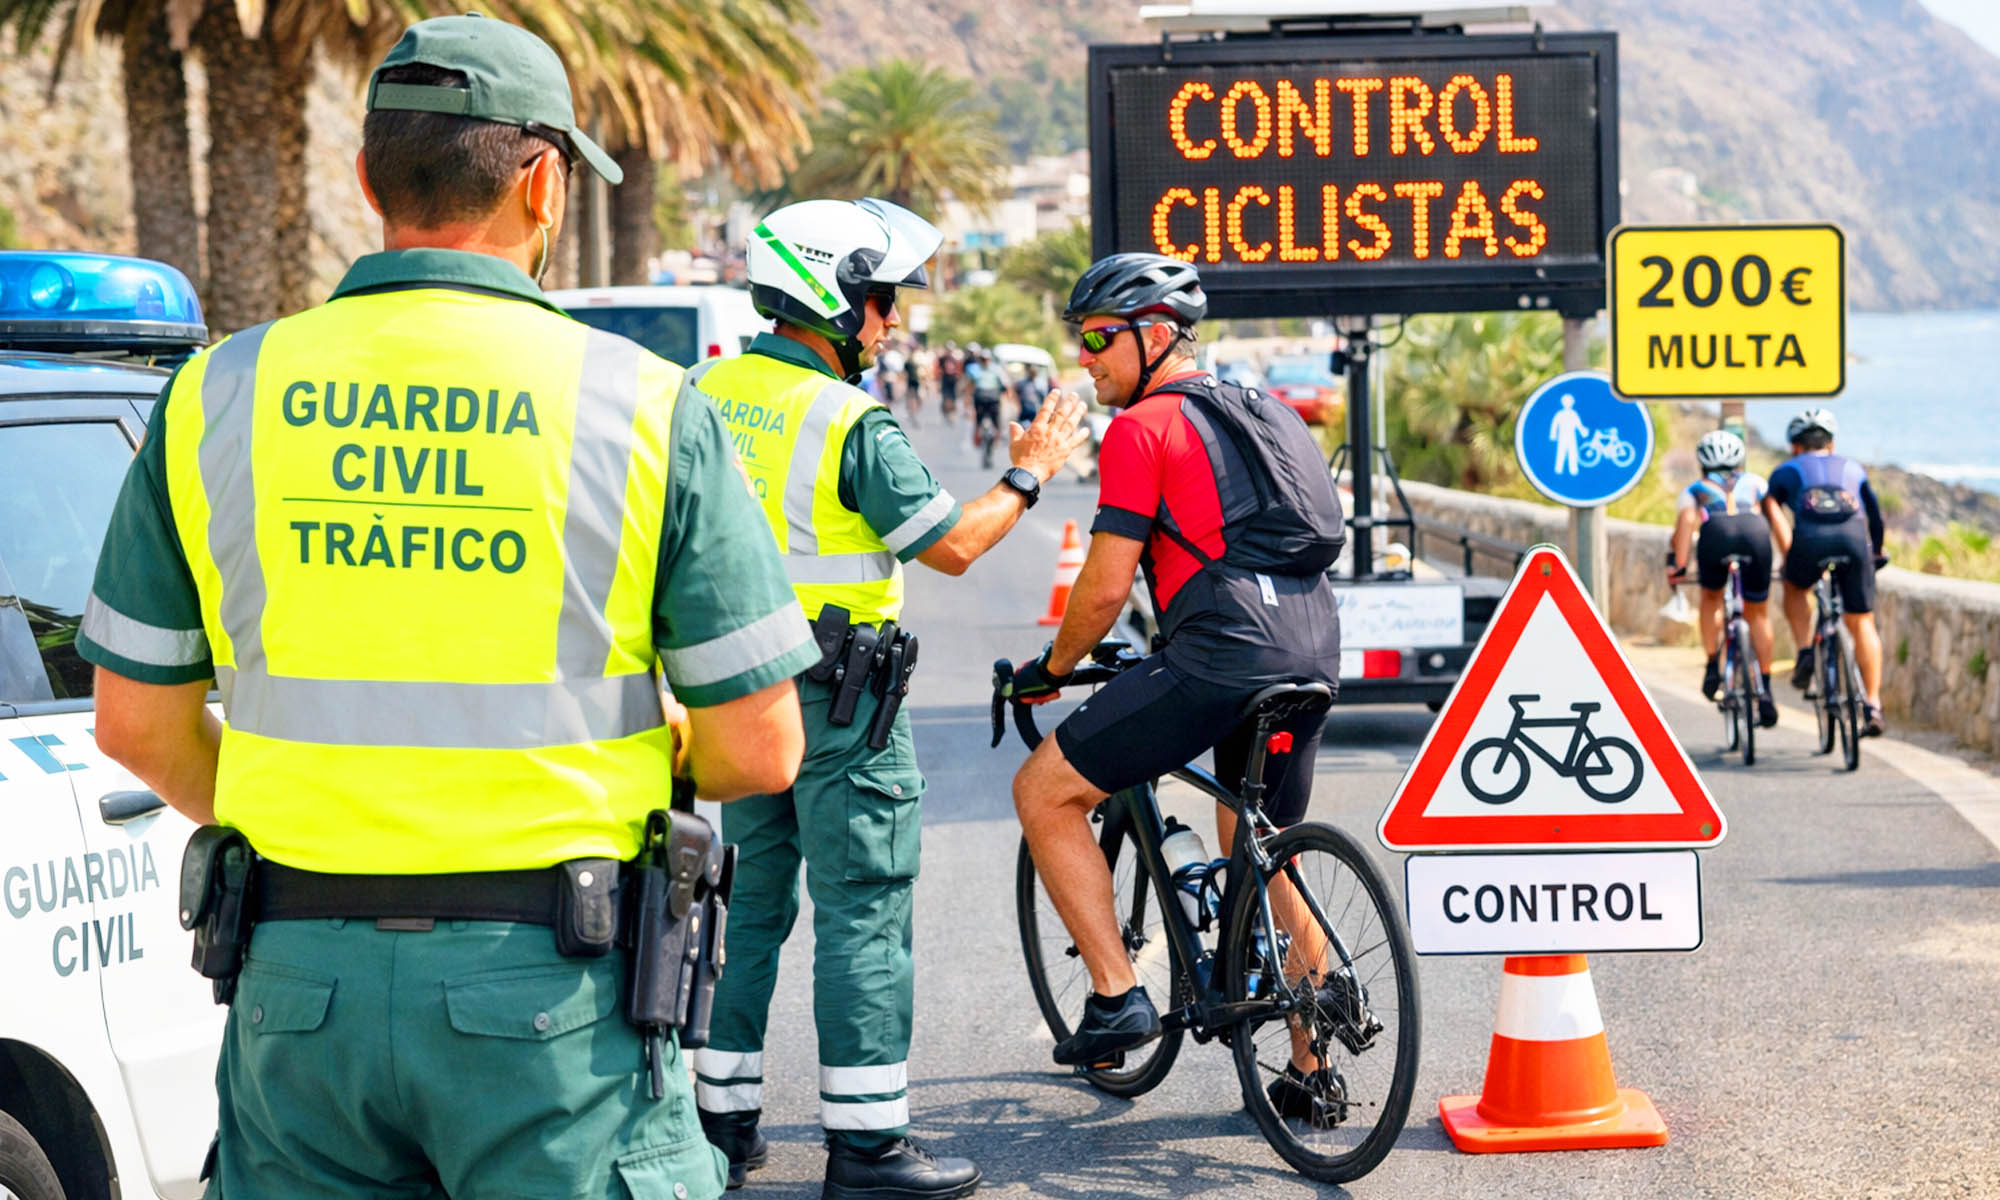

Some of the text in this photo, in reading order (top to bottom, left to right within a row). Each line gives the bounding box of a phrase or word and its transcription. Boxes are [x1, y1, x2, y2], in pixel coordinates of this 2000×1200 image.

[1169, 74, 1538, 160] CONTROL
[1151, 180, 1547, 263] CICLISTAS
[1639, 254, 1812, 308] 200€
[1649, 333, 1806, 369] MULTA
[282, 380, 540, 436] GUARDIA
[332, 443, 484, 496] CIVIL
[4, 841, 160, 919] GUARDIA
[1443, 883, 1663, 924] CONTROL
[52, 912, 144, 978] CIVIL
